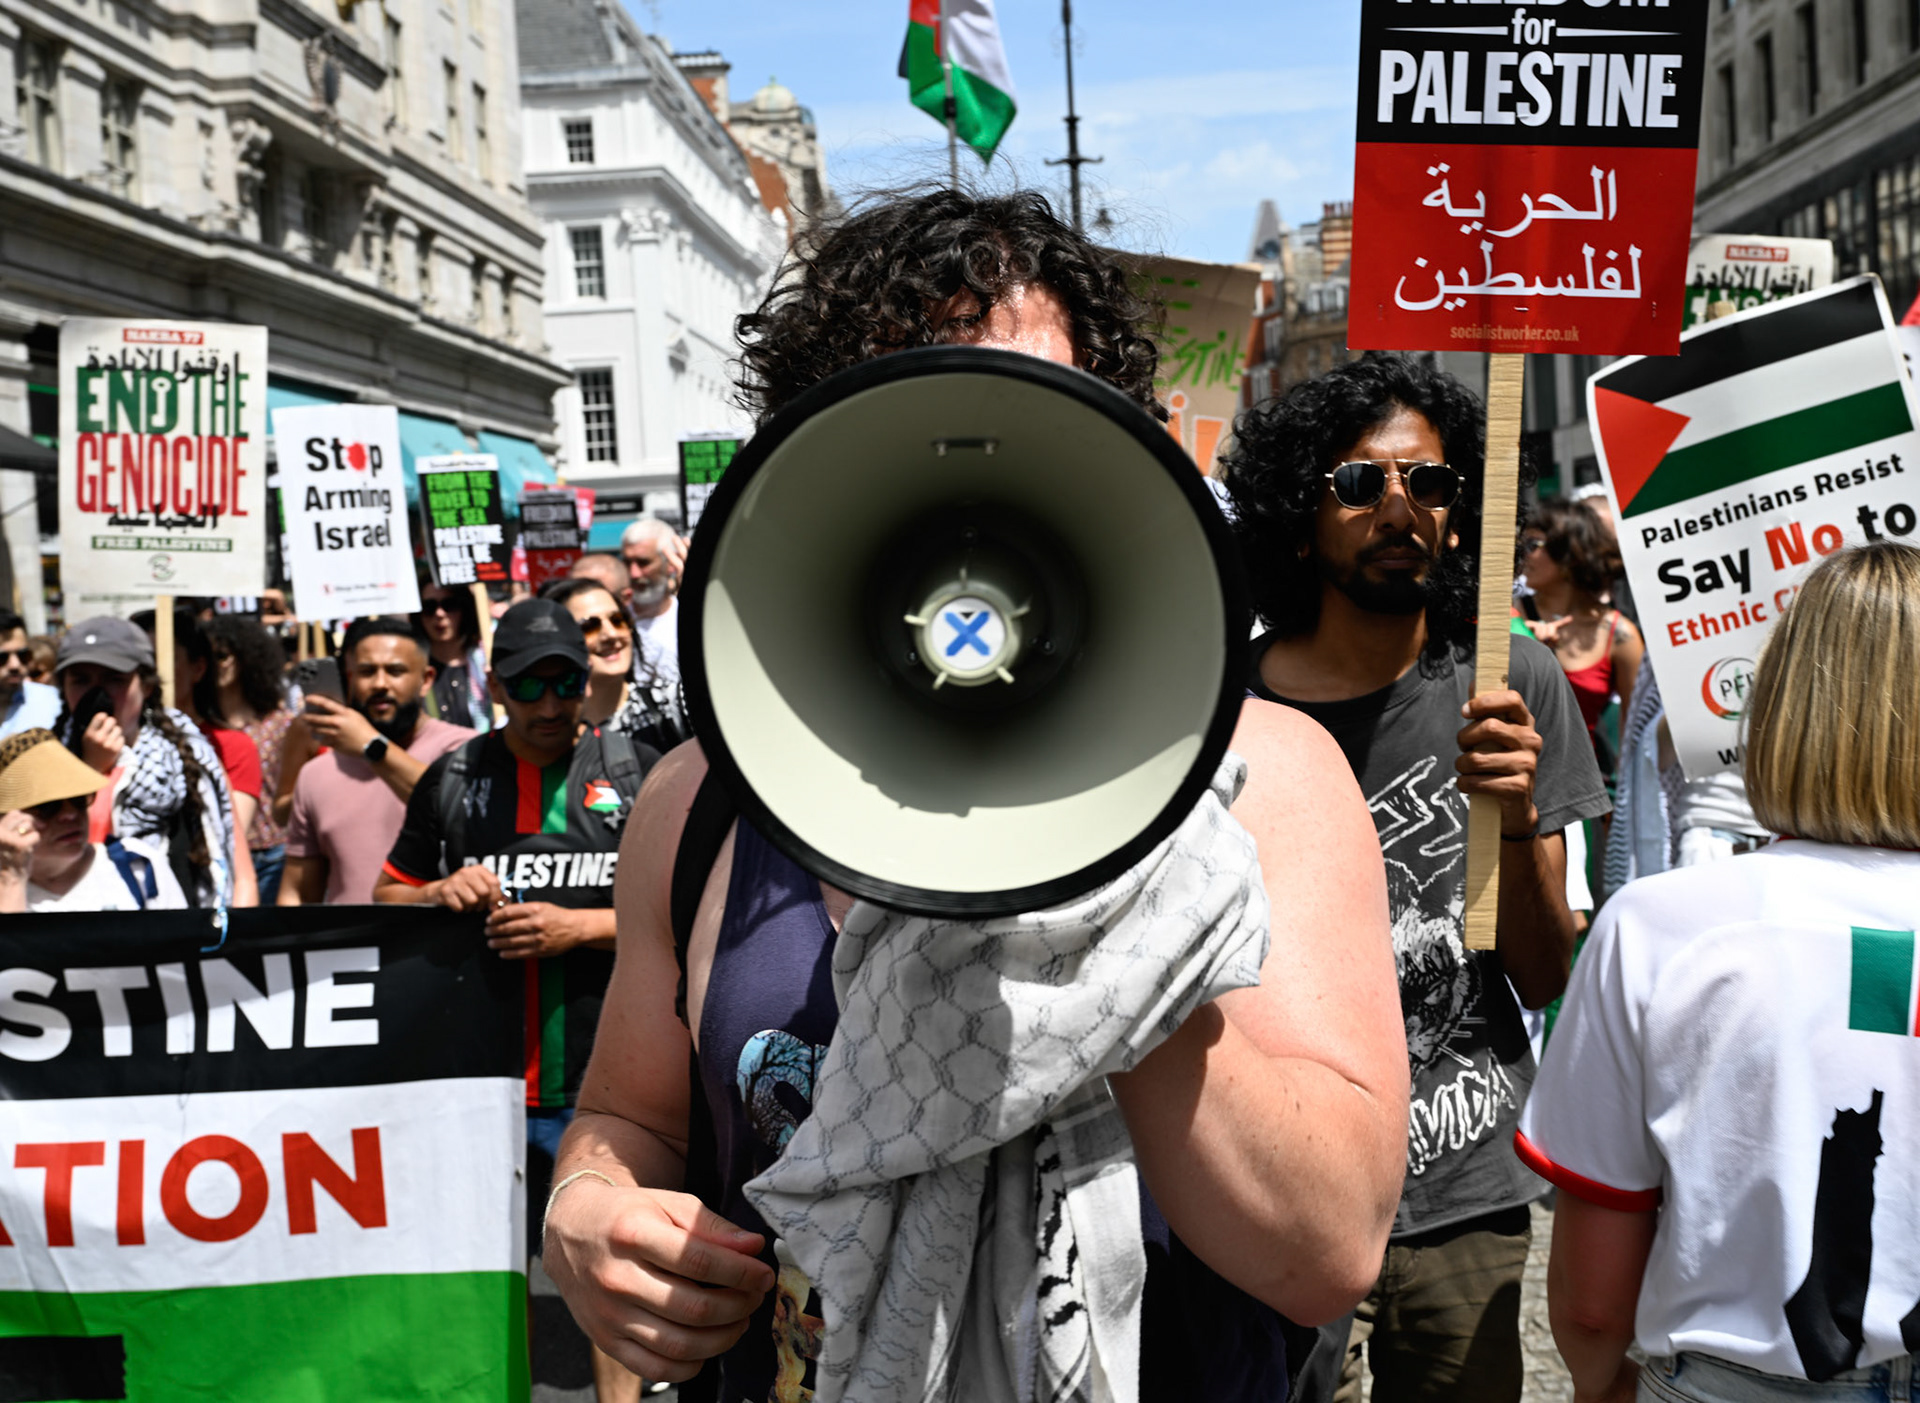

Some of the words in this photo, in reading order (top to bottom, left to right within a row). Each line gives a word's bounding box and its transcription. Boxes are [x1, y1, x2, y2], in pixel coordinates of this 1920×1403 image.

[1511, 8, 1556, 45] for
[1377, 50, 1683, 128] PALESTINE
[1422, 162, 1618, 238] الحرية
[1394, 239, 1643, 312] لفلسطين
[1450, 323, 1580, 341] socialistworker.co.uk
[76, 366, 179, 434] END
[191, 371, 250, 437] THE
[77, 432, 248, 516] GENOCIDE
[305, 481, 393, 515] Arming
[1641, 485, 1807, 548] Palestinians
[1814, 453, 1905, 498] Resist
[314, 517, 392, 551] Israel
[1657, 547, 1752, 604] Say
[1763, 520, 1844, 572] No
[1856, 502, 1917, 543] to
[1666, 599, 1768, 647] Ethnic
[0, 946, 380, 1062] STINE
[0, 1126, 388, 1248] TION
